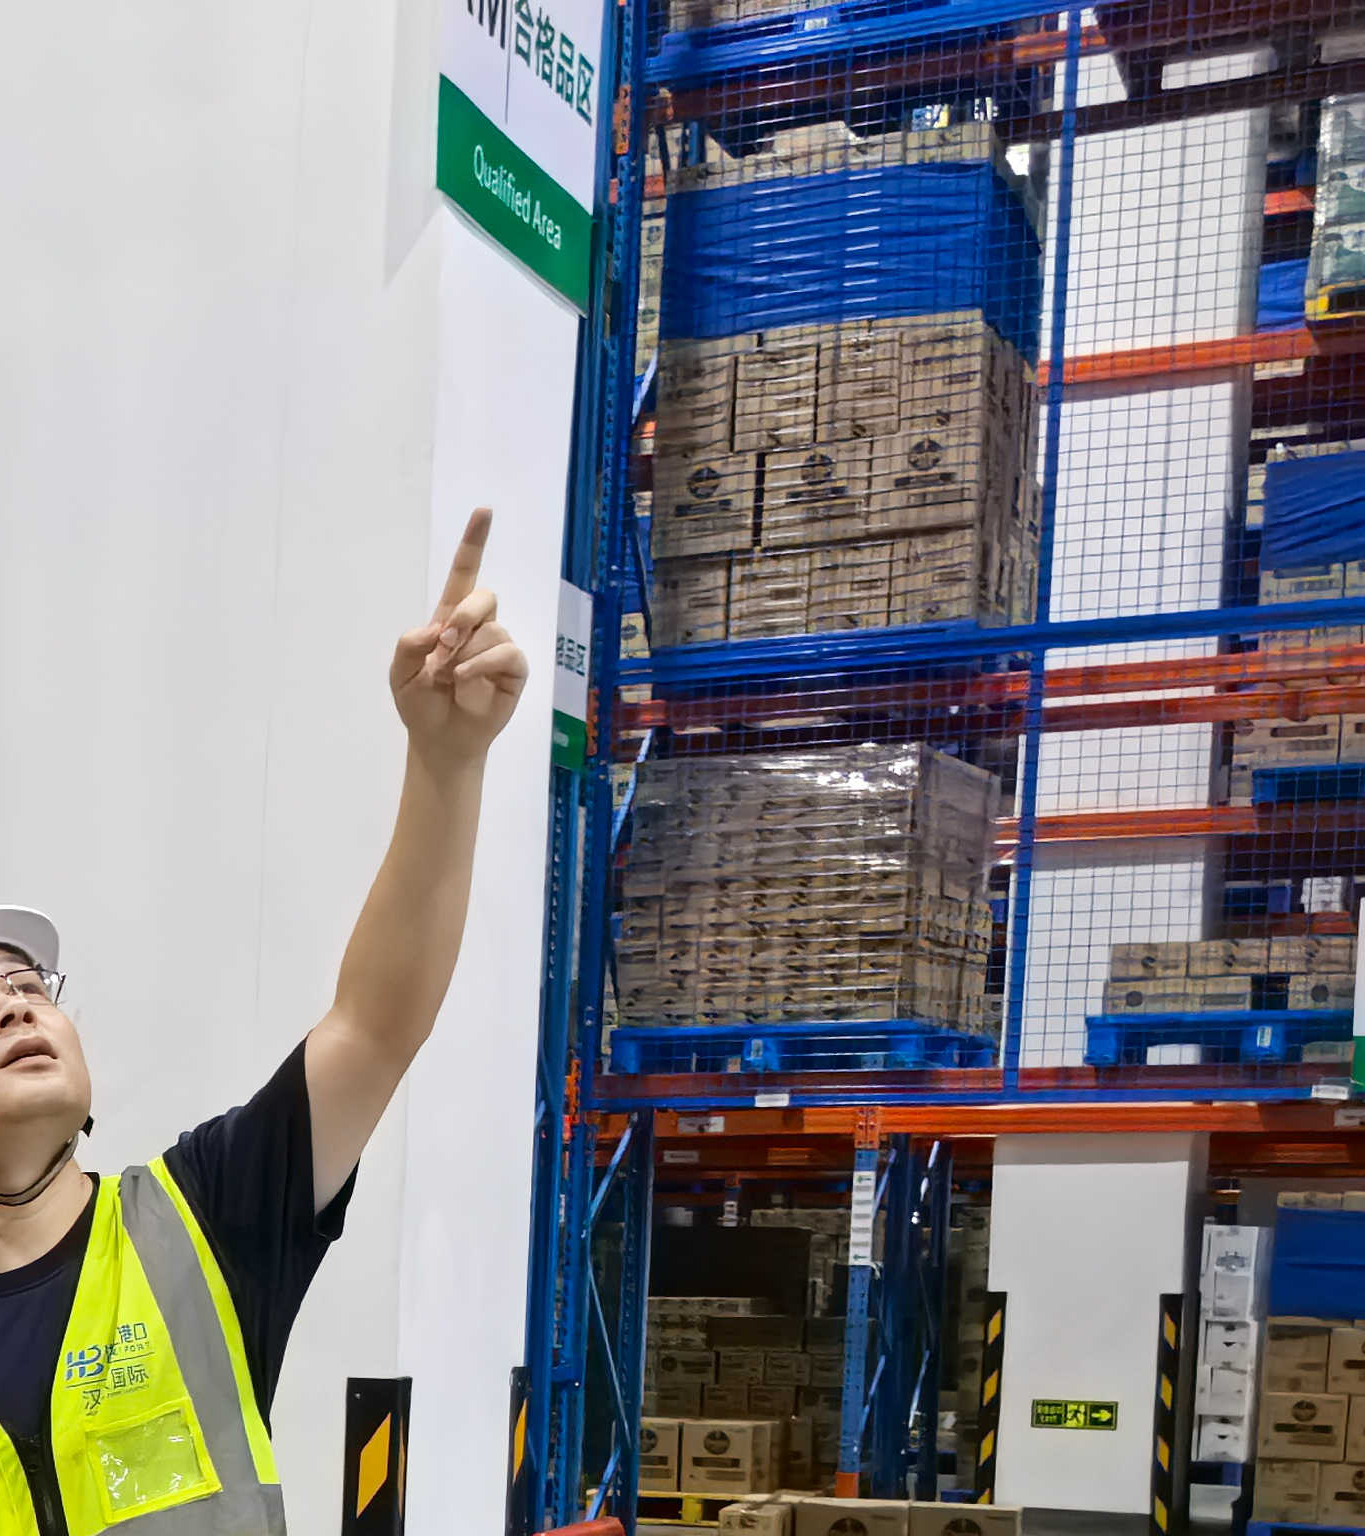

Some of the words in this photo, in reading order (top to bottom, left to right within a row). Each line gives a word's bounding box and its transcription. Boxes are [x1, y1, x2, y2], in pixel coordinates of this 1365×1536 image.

[514, 0, 595, 126] 合格品区
[473, 144, 531, 224] Qualified
[532, 200, 562, 250] Area
[82, 1363, 150, 1410] 汉国际
